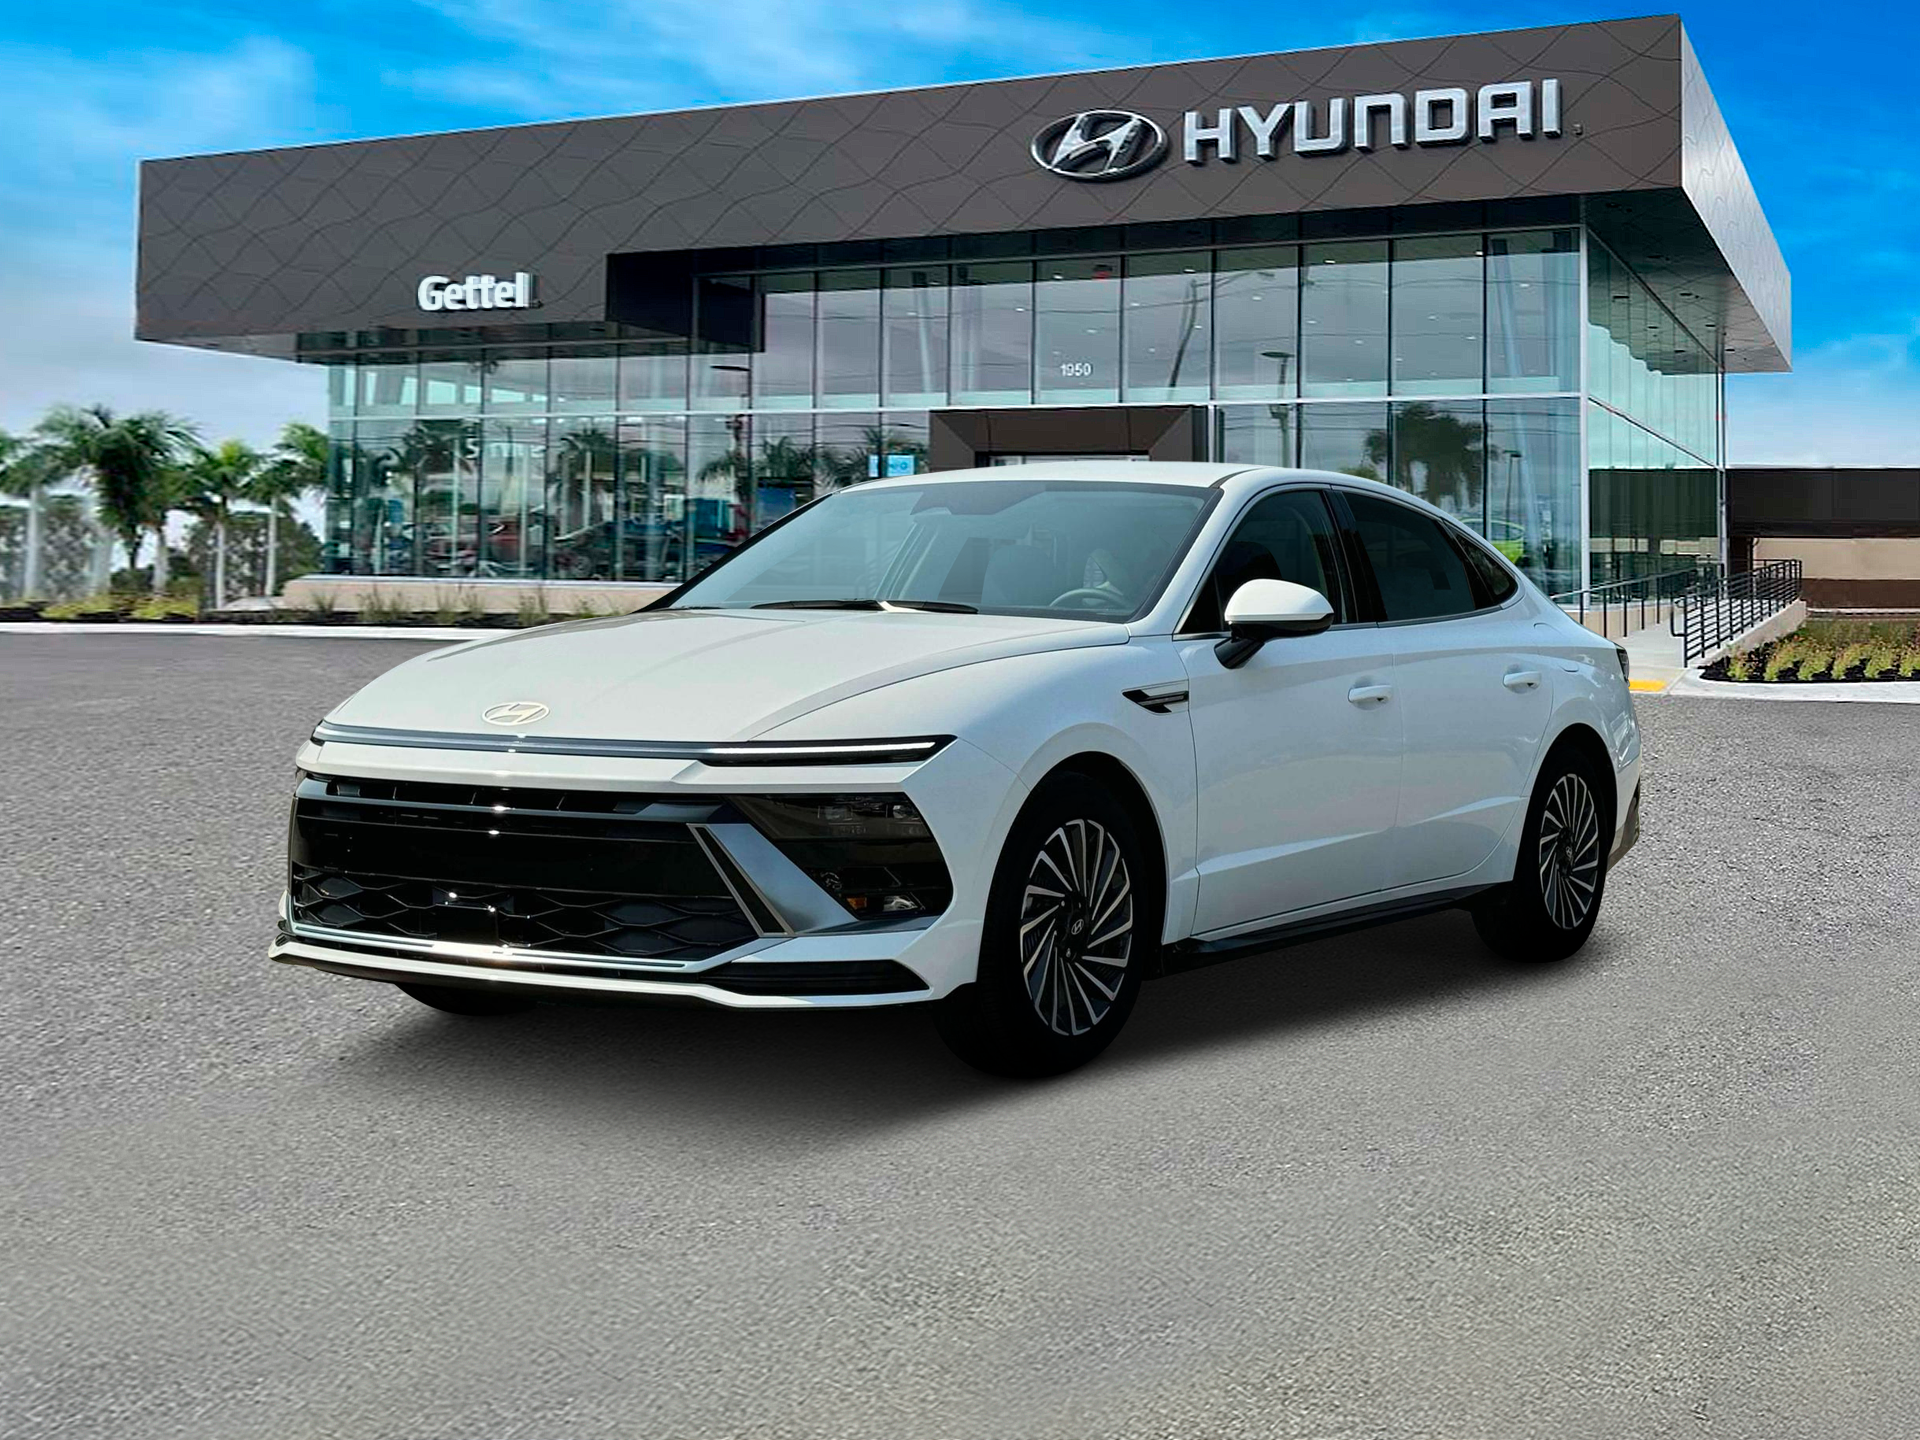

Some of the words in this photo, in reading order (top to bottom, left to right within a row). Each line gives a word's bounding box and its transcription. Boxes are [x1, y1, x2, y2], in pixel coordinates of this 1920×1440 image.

[1183, 78, 1562, 163] HYUNDAI
[417, 271, 531, 311] Gettel
[1060, 362, 1092, 377] 1950
